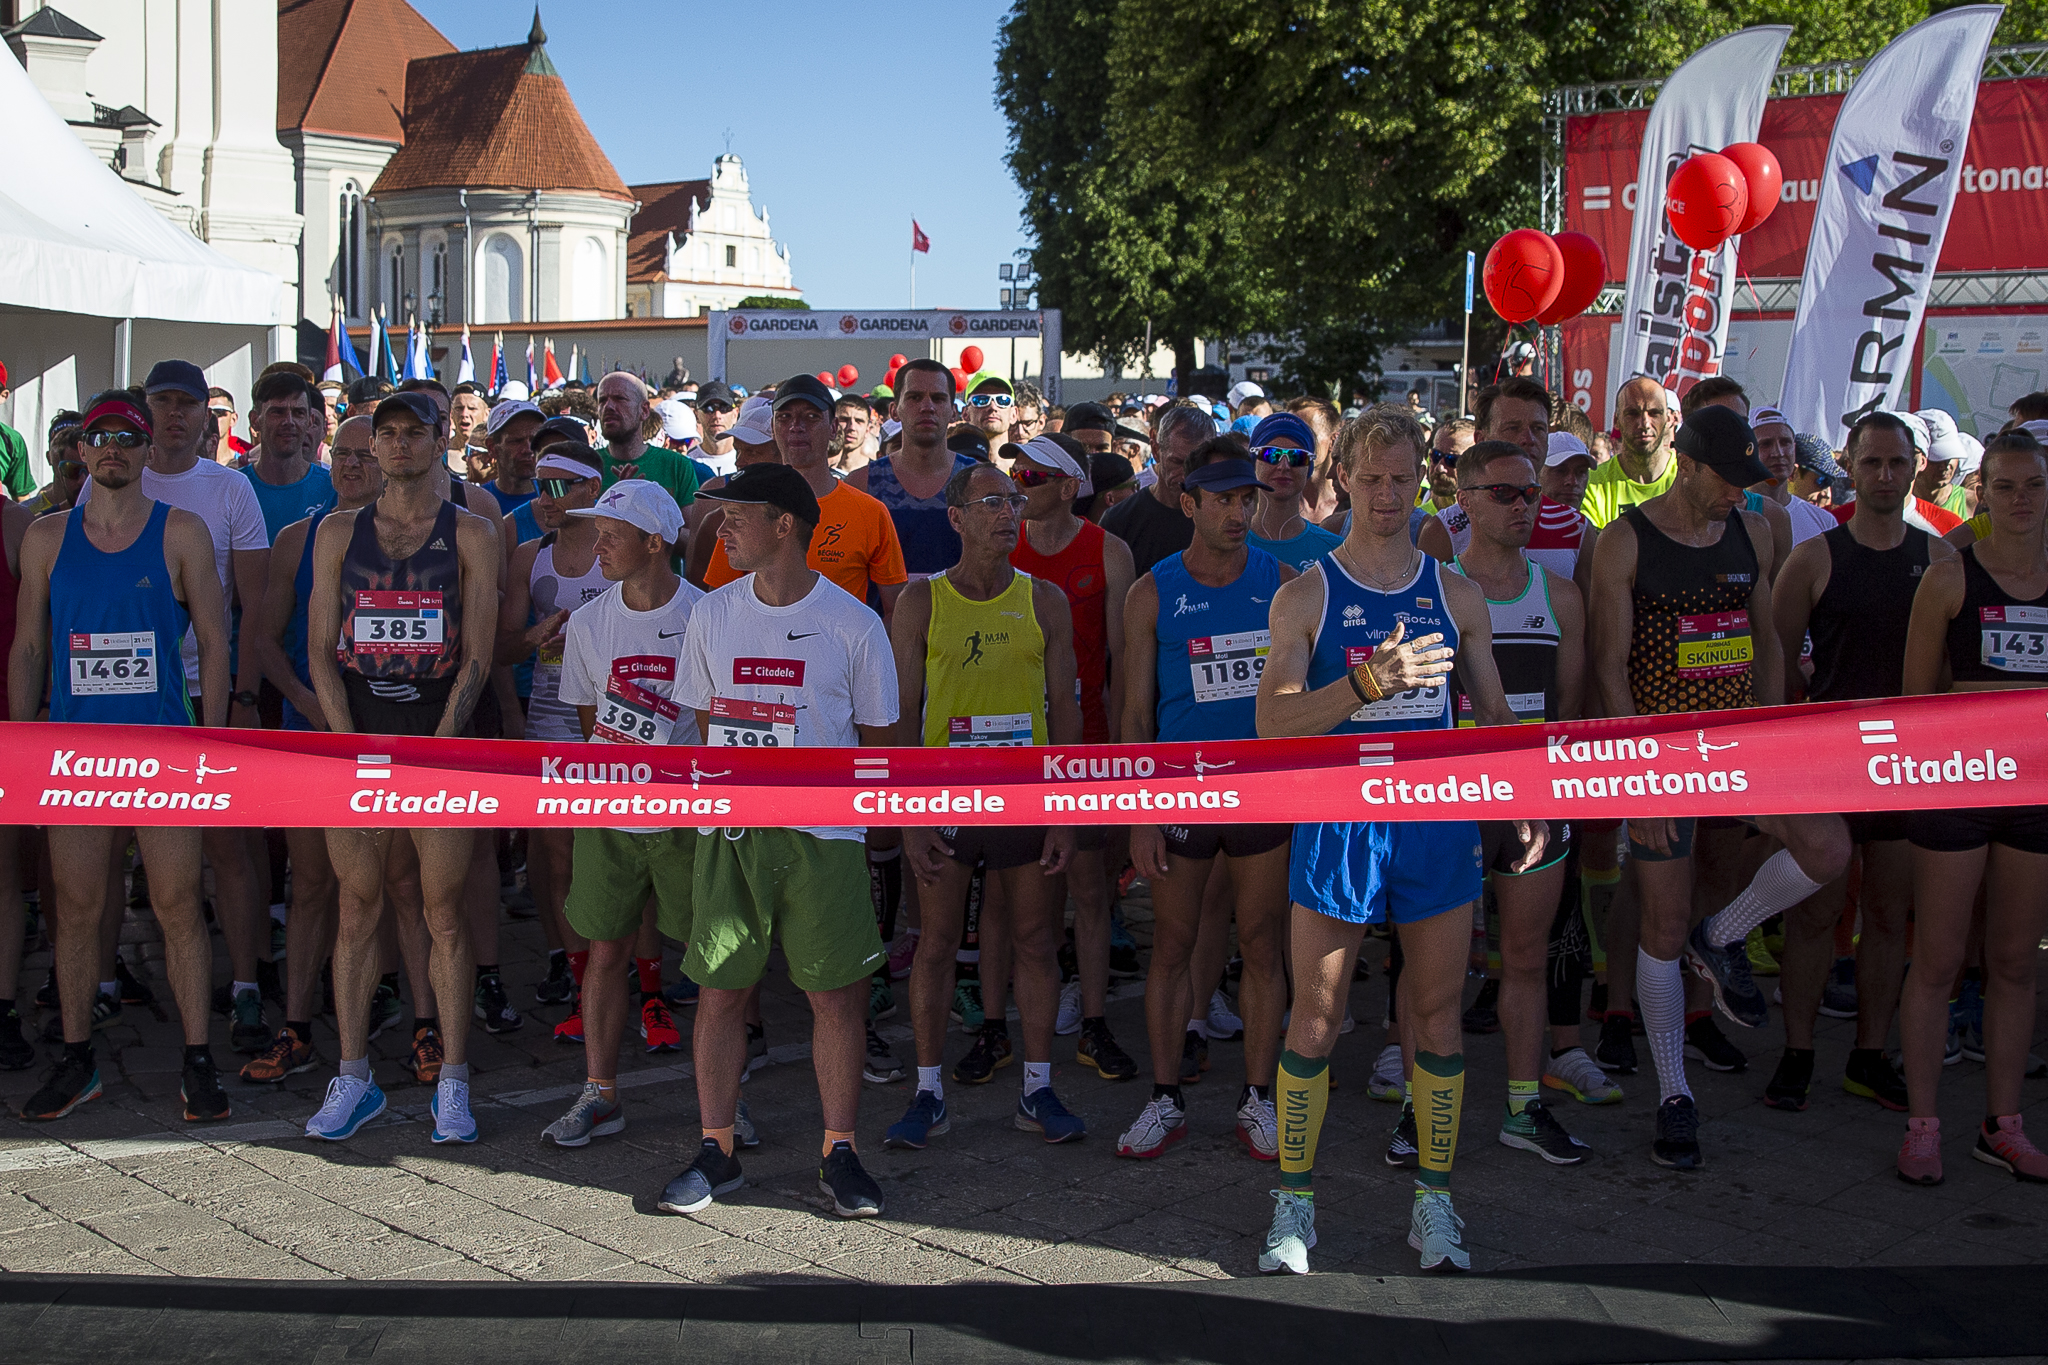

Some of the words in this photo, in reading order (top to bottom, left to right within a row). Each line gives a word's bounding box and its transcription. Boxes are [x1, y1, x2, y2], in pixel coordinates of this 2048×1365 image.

[750, 318, 818, 332] GARDENA
[860, 318, 929, 332] GARDENA
[969, 318, 1039, 332] GARDENA
[369, 619, 428, 640] 385
[1343, 617, 1367, 627] errea
[1711, 631, 1725, 639] 281
[76, 658, 150, 679] 1462
[631, 662, 667, 673] Citadele
[1686, 647, 1748, 665] SKINULIS
[755, 666, 795, 678] Citadele
[1201, 657, 1267, 685] 1189
[601, 704, 657, 741] 398
[1546, 735, 1659, 764] Kauno
[50, 750, 160, 778] Kauno
[540, 756, 652, 784] Kauno
[1043, 754, 1156, 779] Kauno
[1867, 749, 2018, 786] Citadele
[1361, 773, 1514, 805] Citadele
[1551, 769, 1749, 799] maratonas
[39, 787, 232, 811] maratonas
[350, 789, 499, 814] Citadele
[536, 794, 732, 815] maratonas
[853, 789, 1005, 814] Citadele
[1044, 788, 1241, 812] maratonas
[1285, 1089, 1309, 1162] LIETUVA
[1429, 1088, 1454, 1164] LIETUVA
